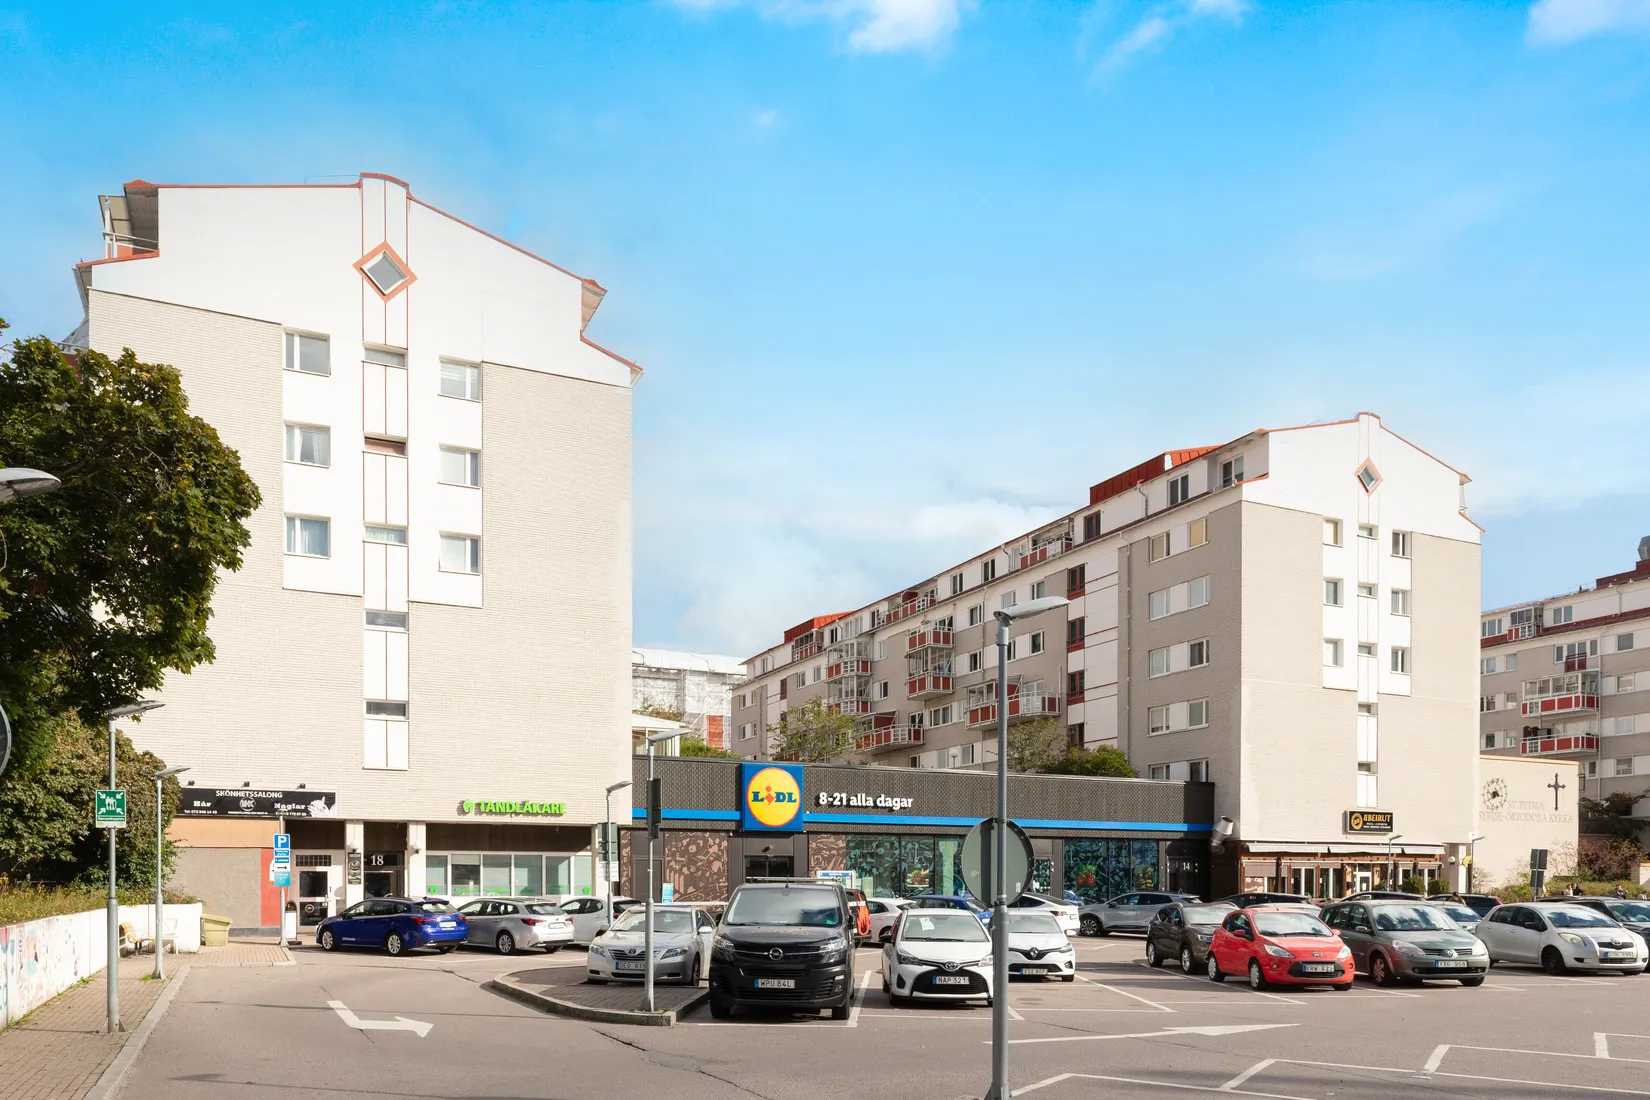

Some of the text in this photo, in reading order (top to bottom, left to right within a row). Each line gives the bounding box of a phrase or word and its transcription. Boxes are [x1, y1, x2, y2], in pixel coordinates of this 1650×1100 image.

[215, 790, 283, 798] SKÖNHETSSALONG
[819, 792, 913, 810] 8-21 alla dagar
[273, 803, 306, 811] Naglar
[1508, 801, 1546, 811] ST PETRUS
[1549, 814, 1573, 823] KYRKA
[277, 836, 287, 848] P
[371, 855, 384, 865] 18
[1182, 862, 1190, 870] 14
[760, 980, 791, 988] WPU 84L
